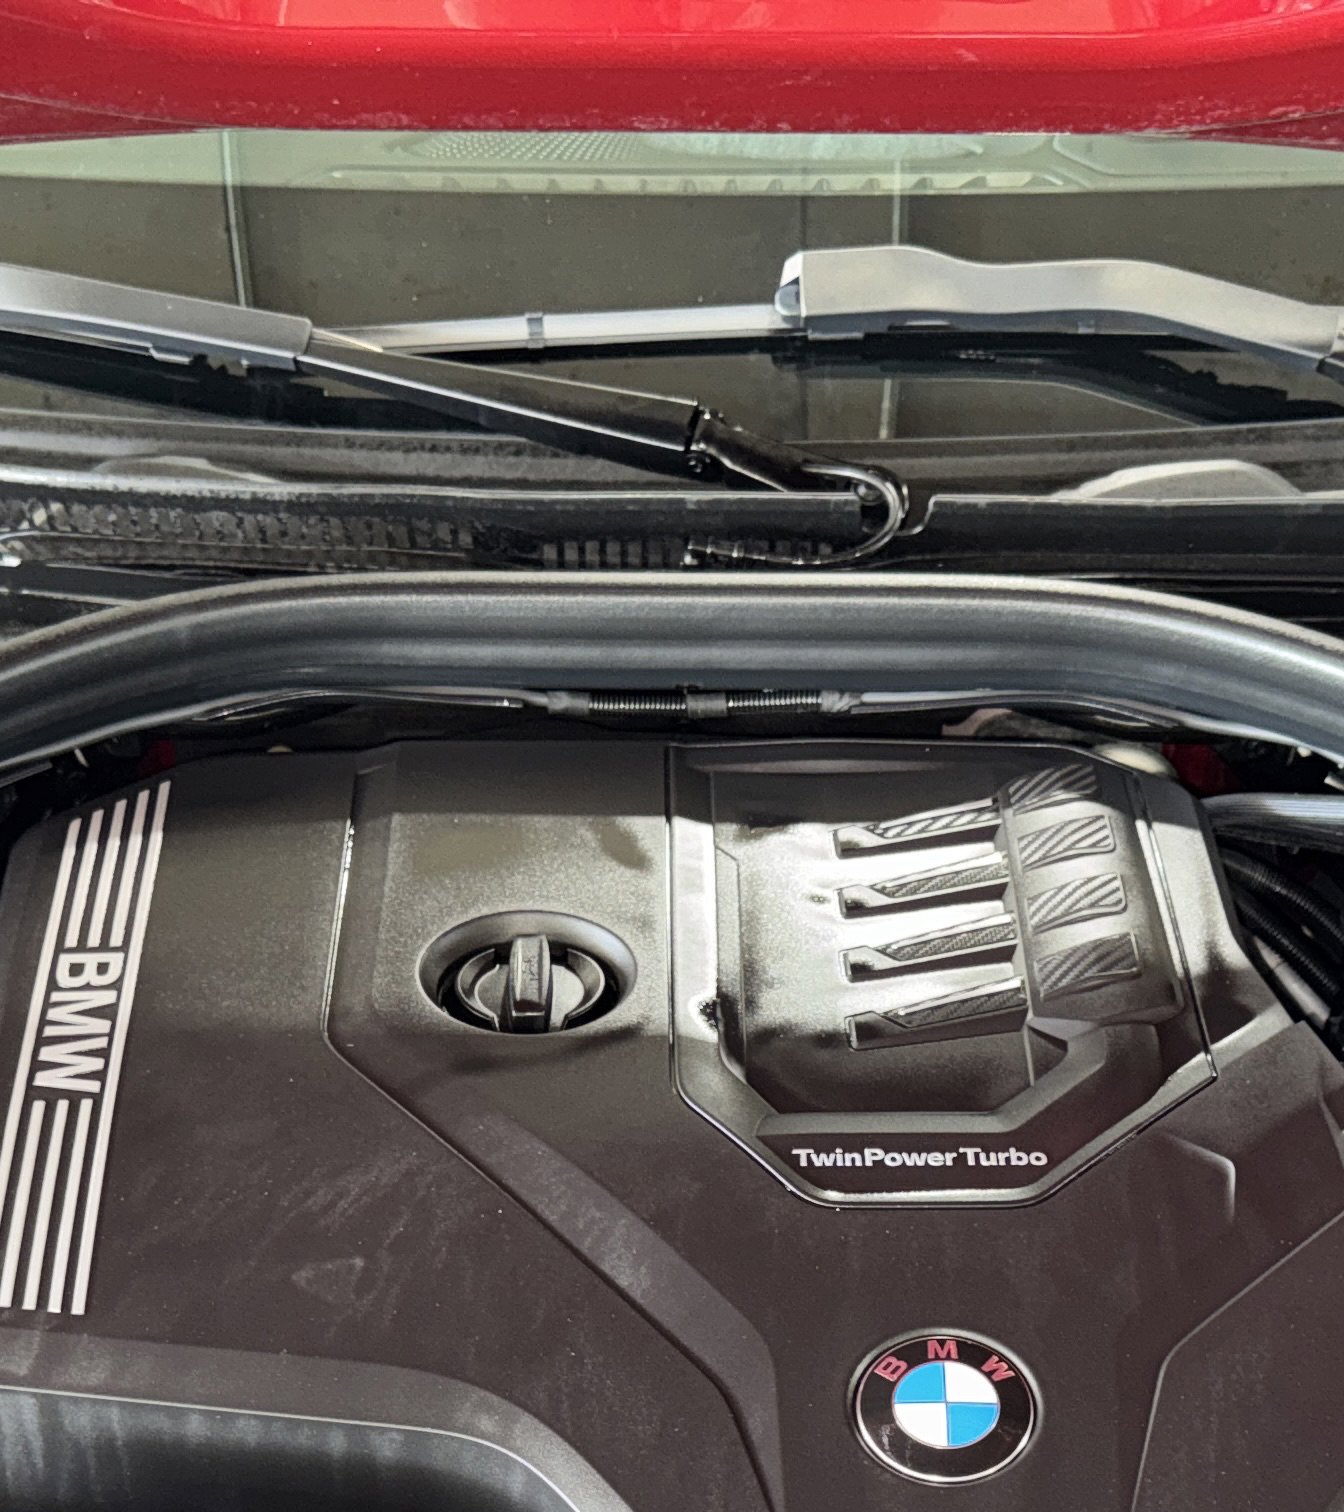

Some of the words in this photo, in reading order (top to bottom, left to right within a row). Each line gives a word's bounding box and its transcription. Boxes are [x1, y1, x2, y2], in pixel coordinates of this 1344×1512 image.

[32, 948, 126, 1094] BMW
[791, 1146, 956, 1169] TwinPower
[959, 1146, 1048, 1169] Turbo
